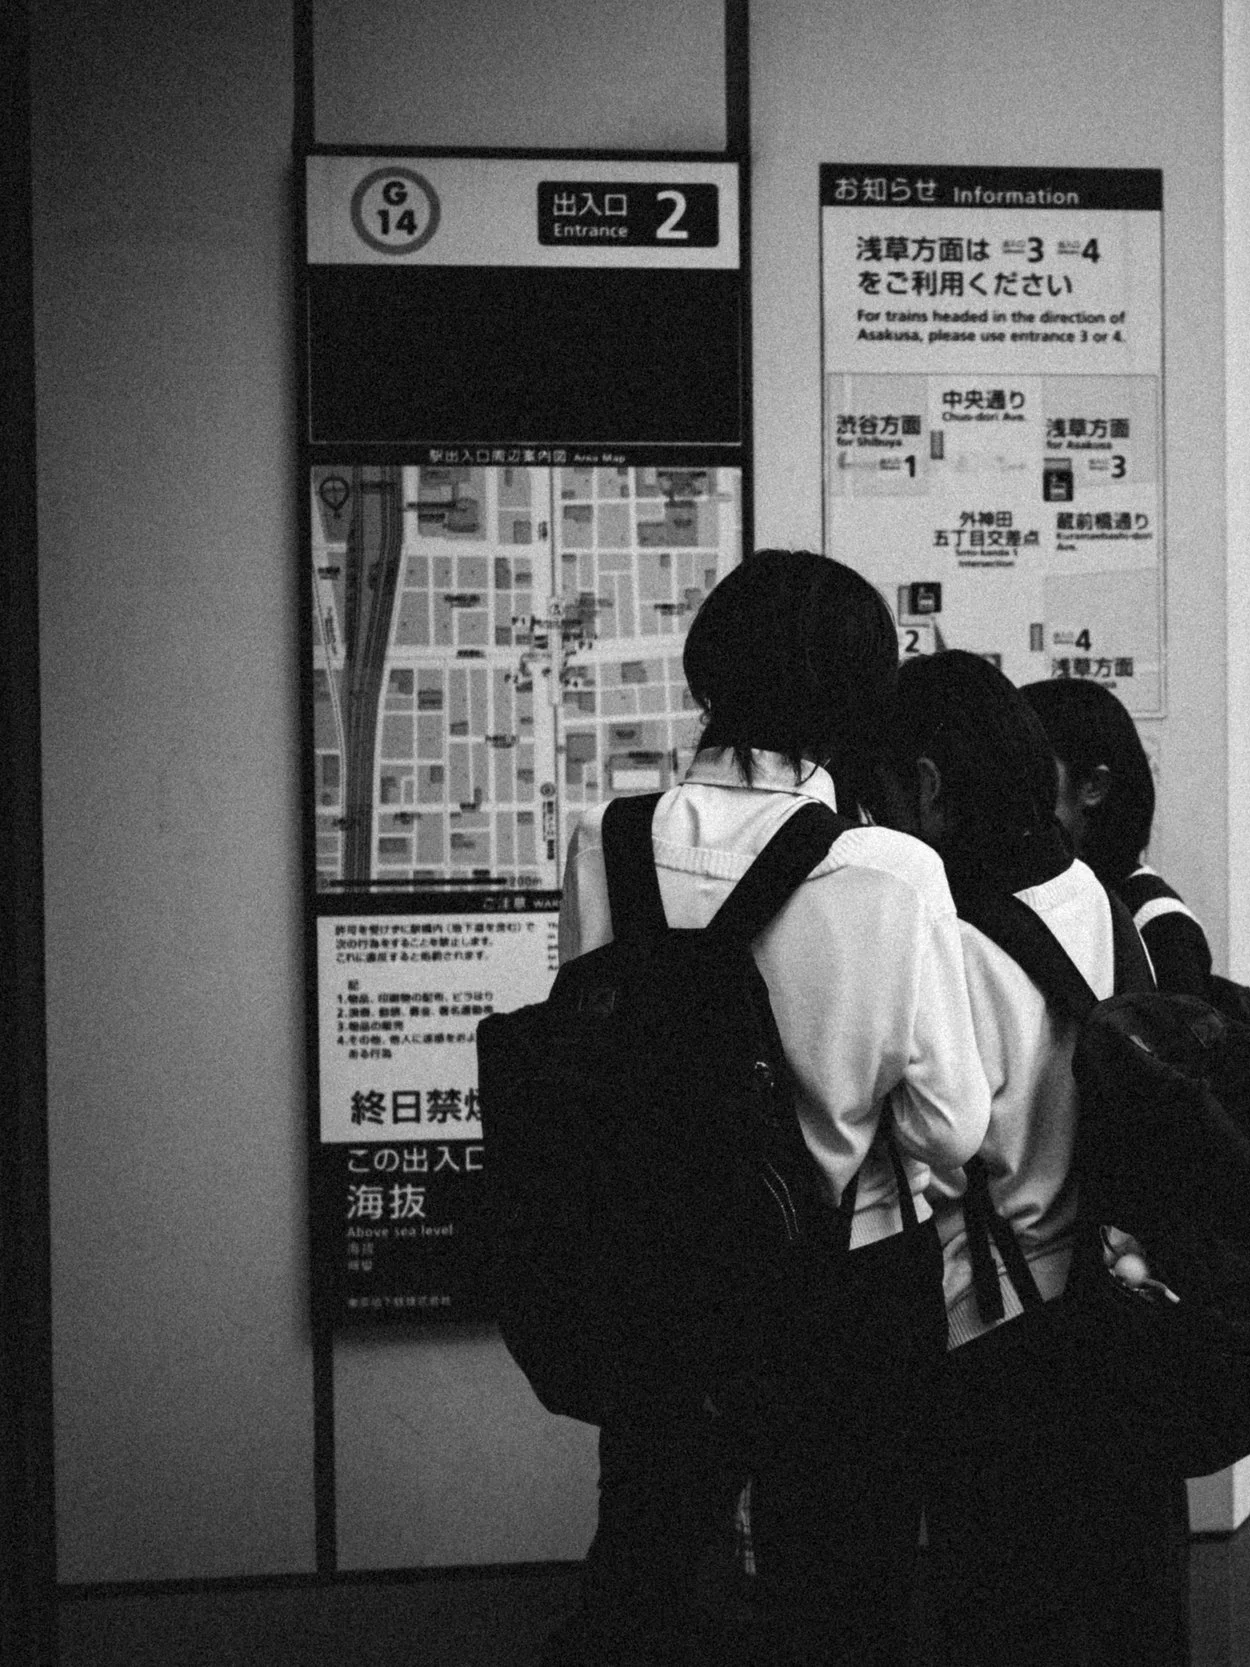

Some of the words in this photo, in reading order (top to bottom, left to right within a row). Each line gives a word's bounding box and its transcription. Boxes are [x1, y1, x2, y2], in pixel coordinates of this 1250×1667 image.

[382, 181, 408, 207] G
[834, 177, 937, 202] お知らせ
[953, 186, 1080, 206] Information
[553, 193, 627, 217] 出入口
[655, 190, 689, 240] 2
[376, 208, 417, 236] 14
[553, 222, 628, 239] Entrance
[856, 236, 990, 263] 浅草方面は
[1027, 236, 1044, 263] 3
[1081, 238, 1101, 263] 4
[858, 270, 1073, 297] をご利用ください
[857, 309, 881, 323] For
[885, 309, 928, 323] trains
[932, 310, 988, 324] headed
[992, 310, 1007, 324] in
[1010, 311, 1036, 325] the
[1040, 310, 1106, 325] direction
[1109, 310, 1126, 325] of
[857, 328, 923, 344] Asakusa,
[928, 329, 976, 345] please
[980, 332, 1005, 342] use
[1010, 330, 1076, 344] entrance
[1079, 330, 1089, 344] 3
[1092, 333, 1109, 344] or
[942, 389, 1026, 410] 中央通り
[836, 415, 921, 436] 渋谷方面
[942, 411, 1000, 423] Chuo-dori
[1046, 418, 1130, 439] 浅草方面
[836, 437, 854, 448] for
[857, 437, 903, 450] Shibuya
[1046, 440, 1064, 450] for
[904, 455, 916, 478] 1
[1111, 455, 1127, 479] 3
[959, 511, 1013, 528] 外神田
[1057, 512, 1149, 531] 蔵前橋通り
[933, 530, 1040, 548] 五丁目交差点
[904, 630, 920, 653] 2
[1075, 629, 1092, 652] 4
[347, 1184, 426, 1219] 海抜
[347, 1226, 390, 1238] Above
[394, 1227, 416, 1238] sea
[421, 1224, 453, 1237] level
